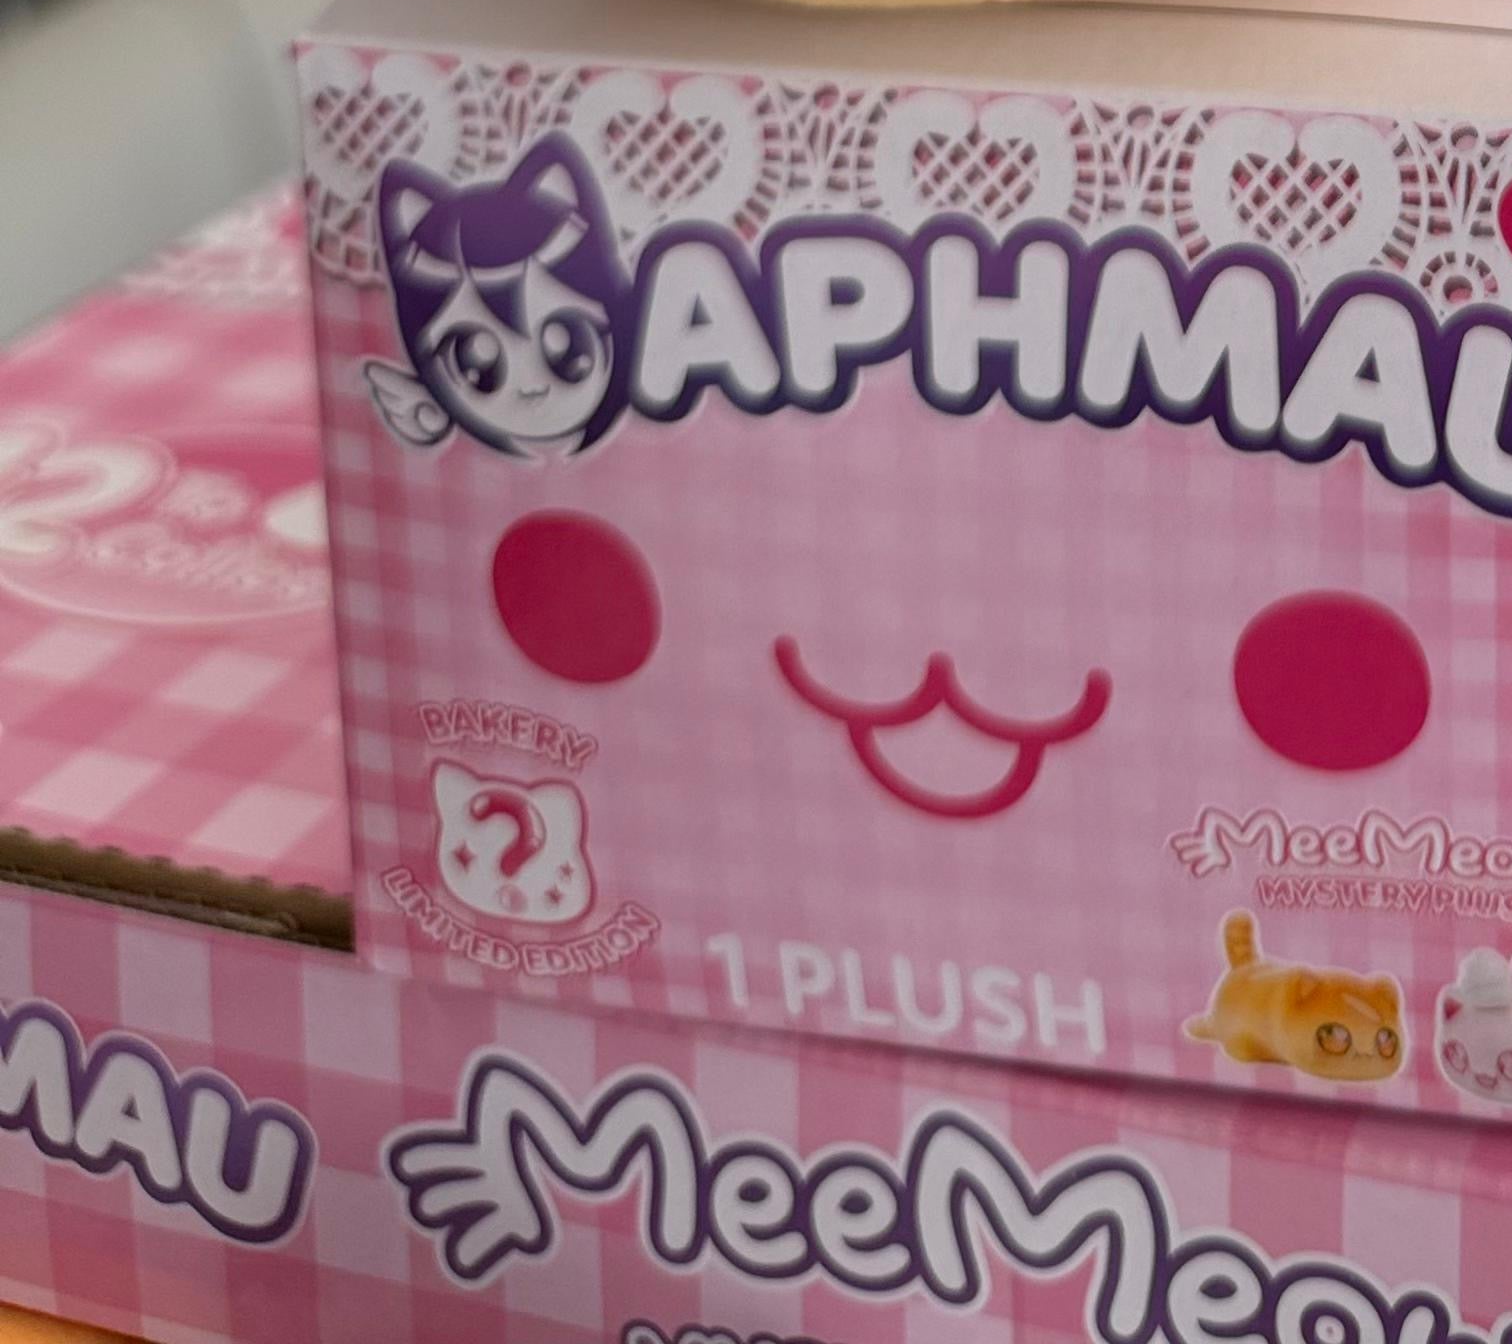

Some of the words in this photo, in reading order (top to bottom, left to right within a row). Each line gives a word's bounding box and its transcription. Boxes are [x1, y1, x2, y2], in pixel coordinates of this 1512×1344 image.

[419, 699, 599, 773] BAKERY
[381, 865, 521, 970] LIMITED
[520, 900, 663, 976] EDITION
[1255, 875, 1430, 914] MYSTERY
[706, 931, 750, 1009] 1
[778, 939, 1108, 1055] PLUSH
